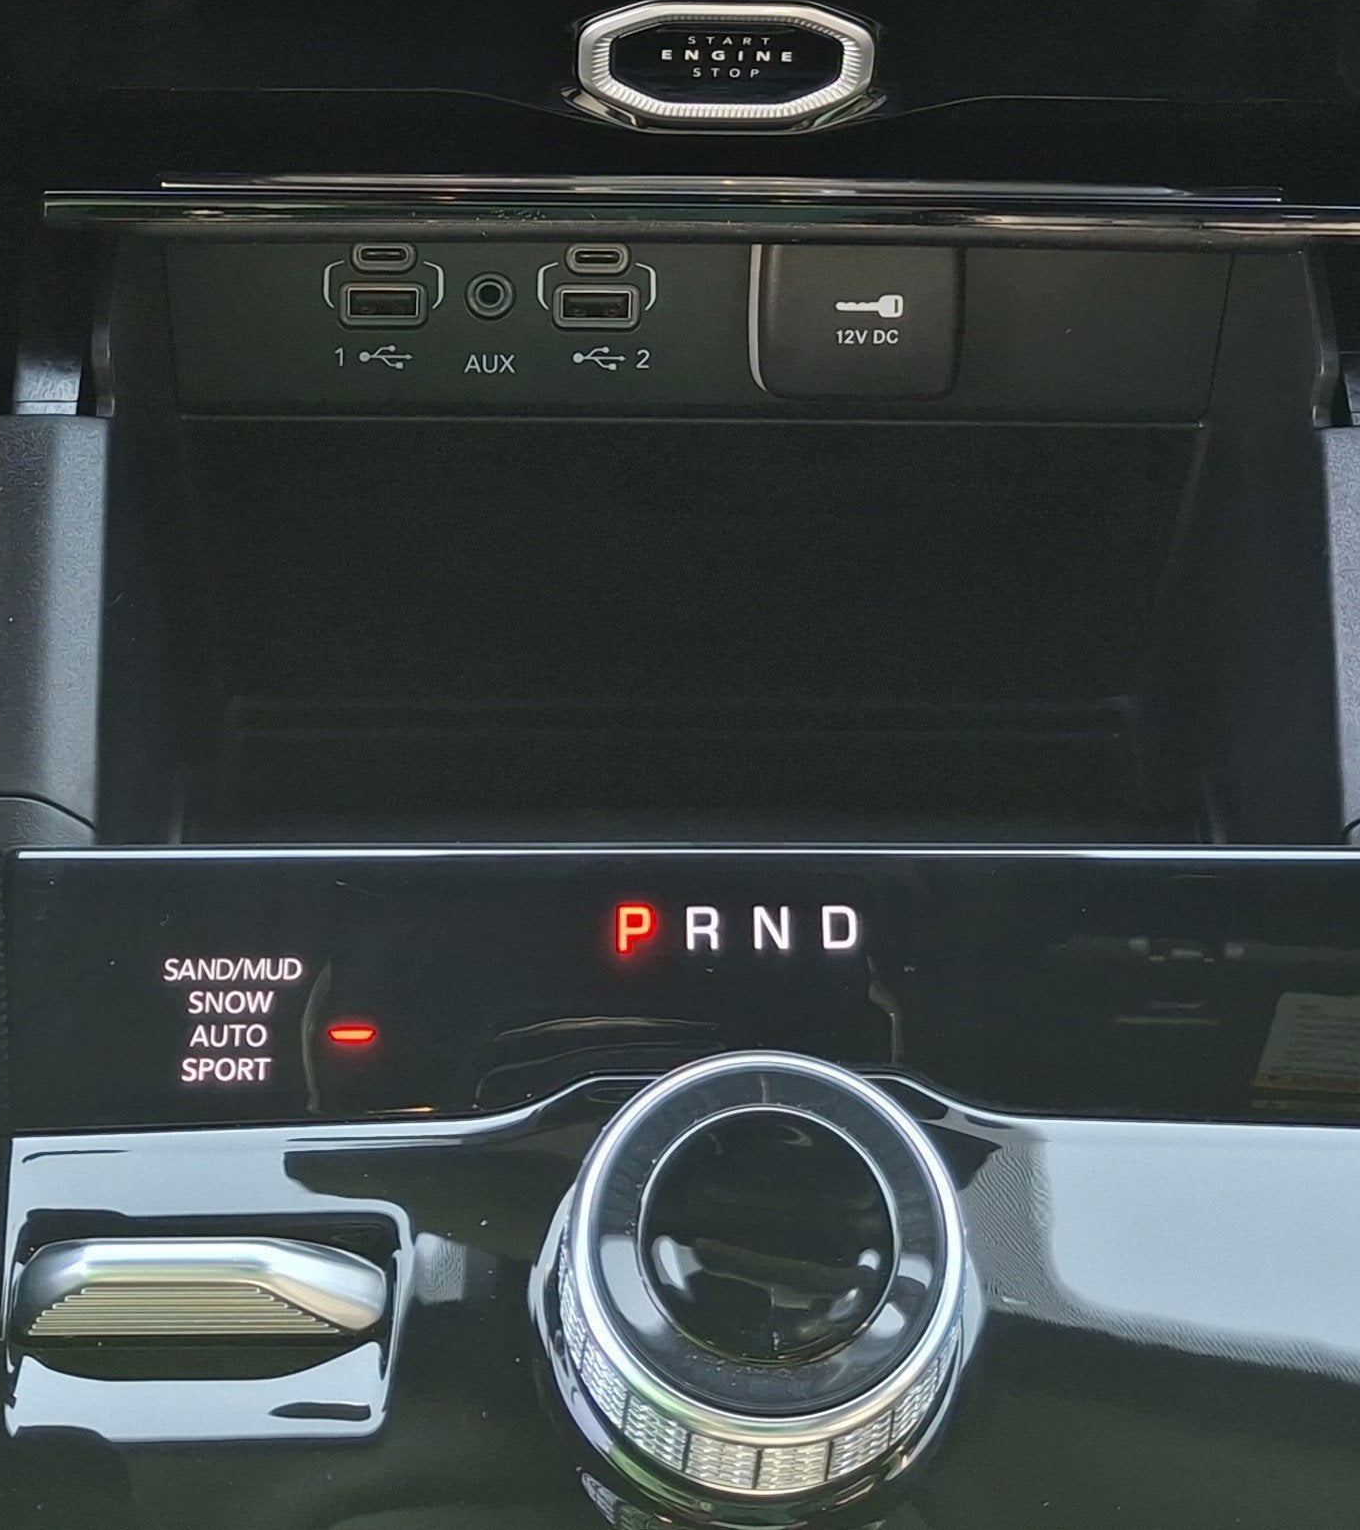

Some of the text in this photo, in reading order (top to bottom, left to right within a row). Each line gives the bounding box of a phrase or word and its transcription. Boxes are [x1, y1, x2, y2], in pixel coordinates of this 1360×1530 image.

[688, 36, 769, 45] START
[662, 50, 792, 62] ENGINE
[693, 67, 759, 78] STOP
[837, 329, 898, 344] 12V DC
[335, 348, 344, 366] 1
[464, 355, 515, 373] AUX
[636, 349, 649, 369] 2
[620, 906, 857, 950] P R N D
[164, 958, 302, 981] SAND/MUD
[188, 991, 273, 1014] SNOW
[190, 1024, 267, 1047] AUTO
[182, 1058, 271, 1081] SPORT
